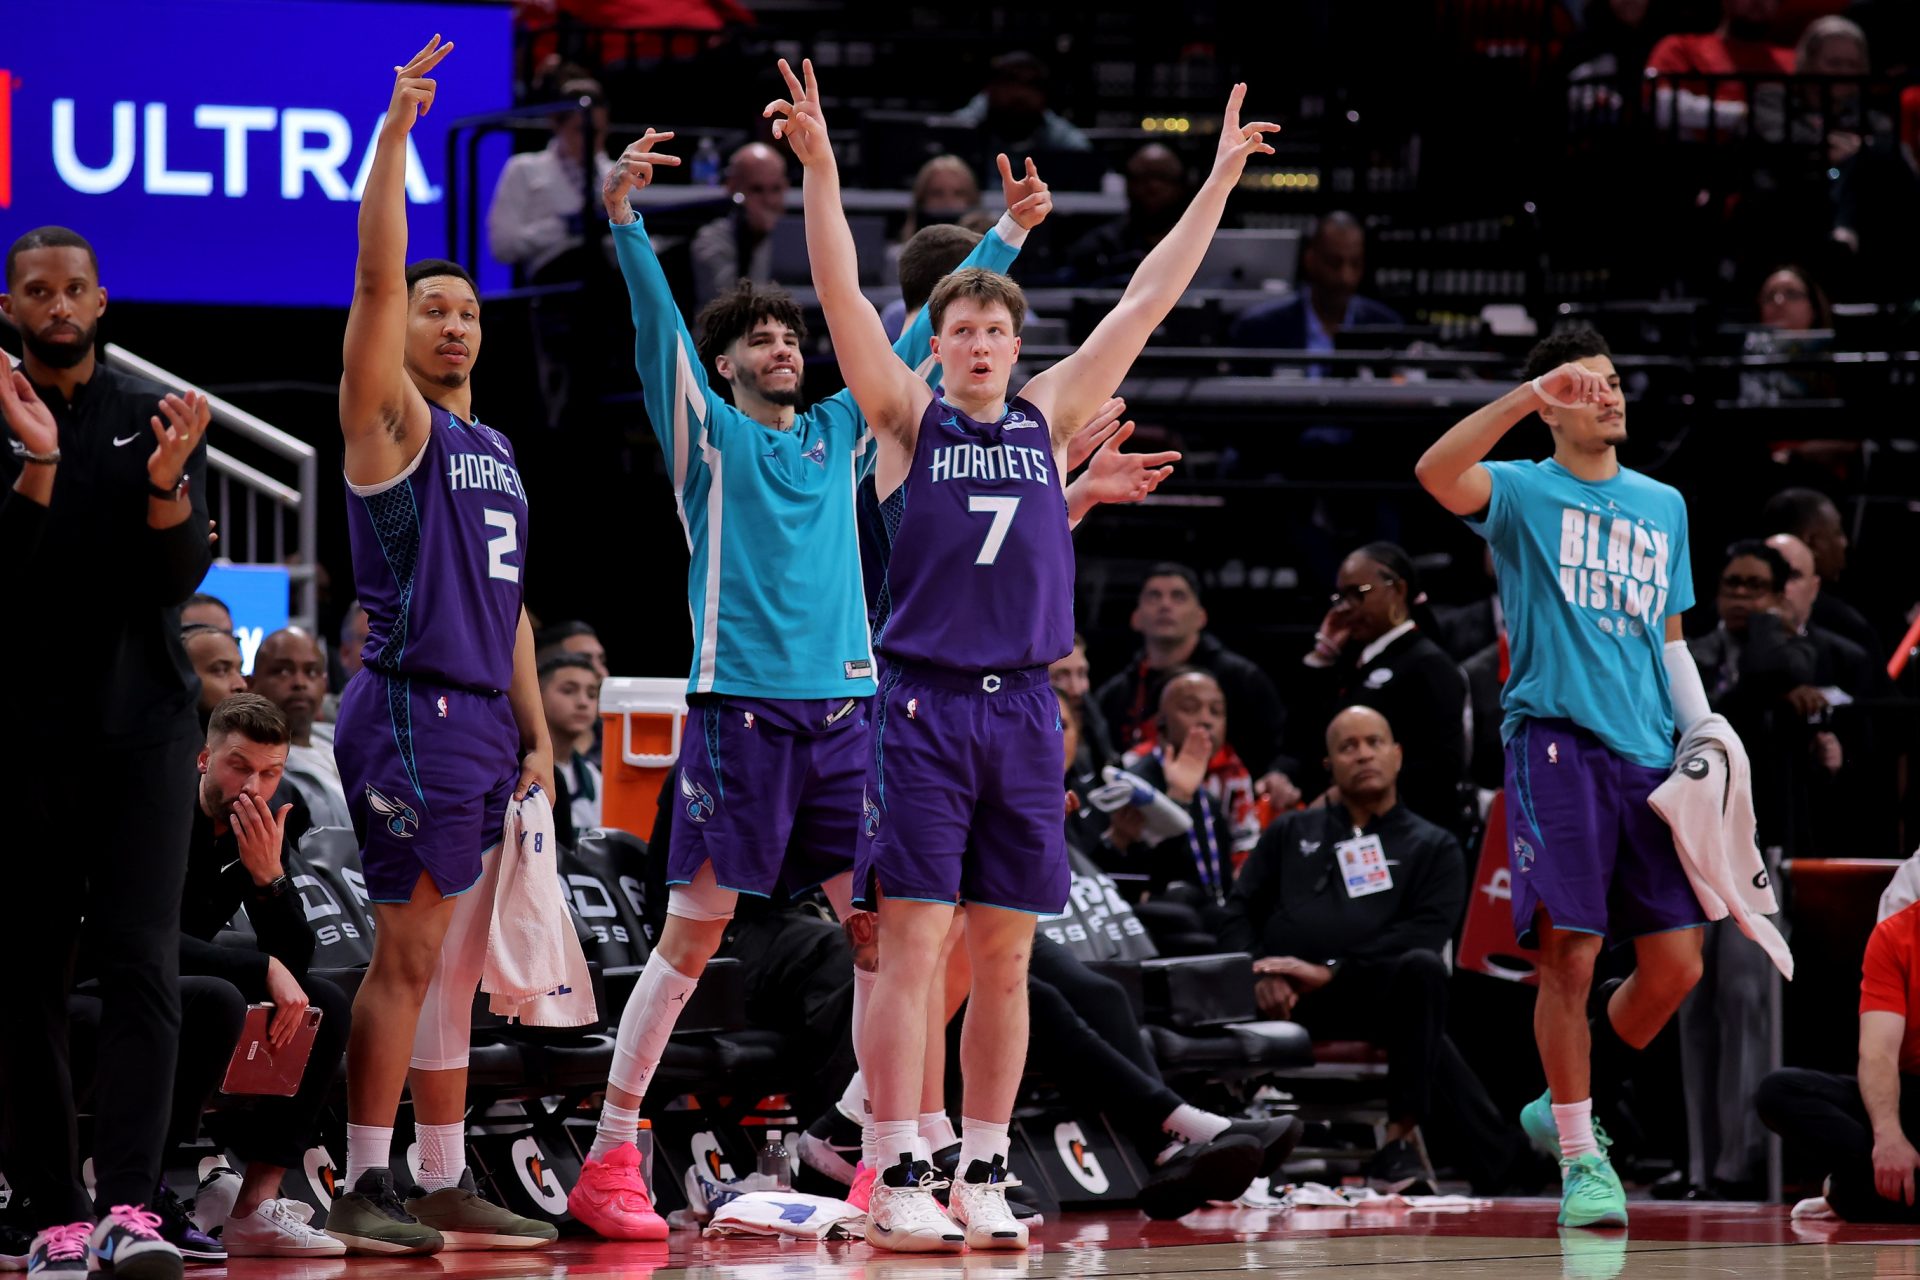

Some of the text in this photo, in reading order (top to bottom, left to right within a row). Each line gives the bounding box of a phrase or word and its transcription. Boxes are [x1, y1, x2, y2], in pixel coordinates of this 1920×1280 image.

[447, 453, 528, 507] HORNET
[928, 443, 1049, 486] HORNETS
[483, 508, 520, 583] 2
[968, 495, 1022, 565] 7
[1559, 507, 1669, 589] BLACK
[511, 1135, 568, 1216] G
[1053, 1120, 1110, 1195] G
